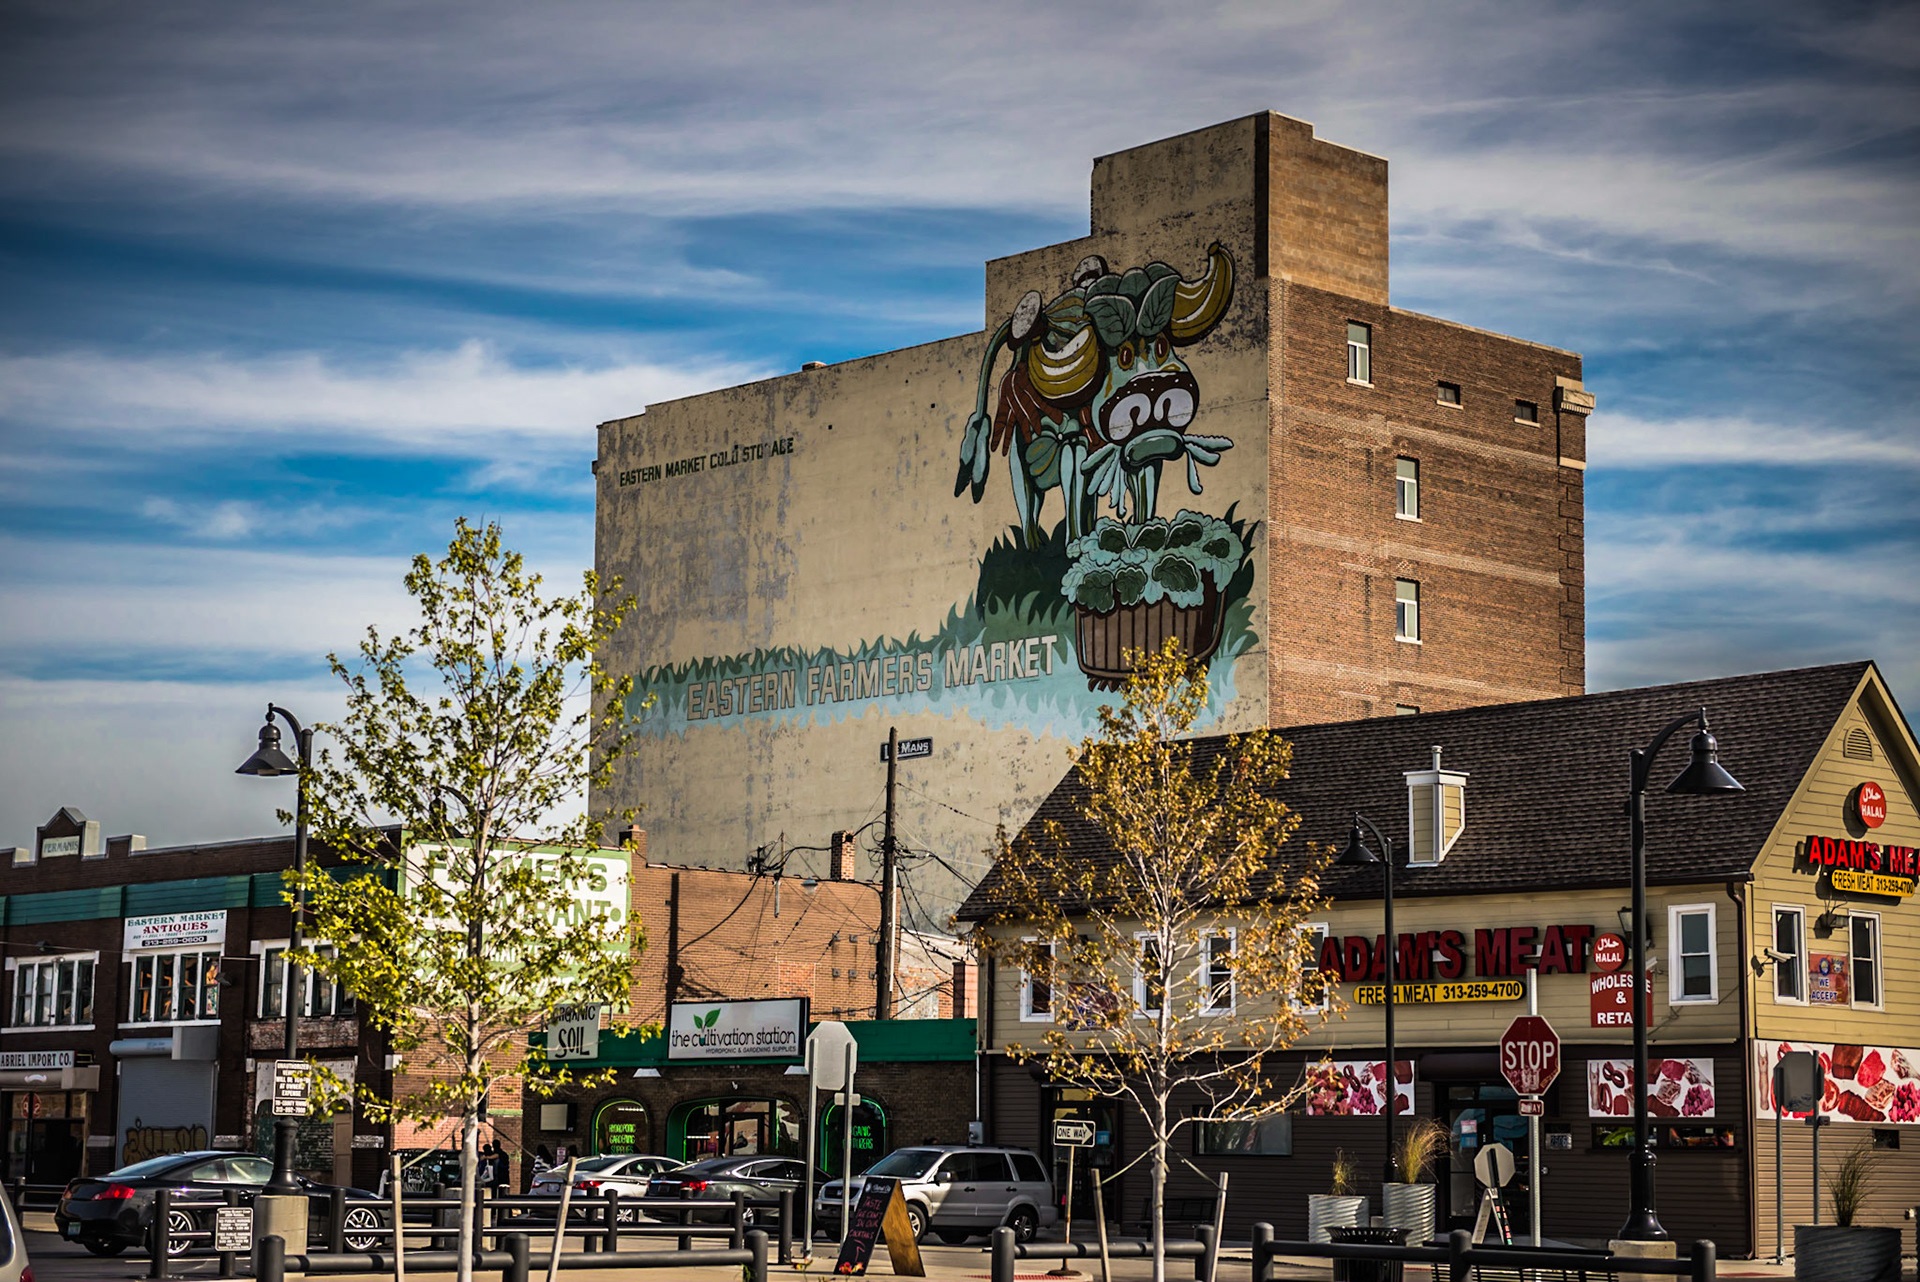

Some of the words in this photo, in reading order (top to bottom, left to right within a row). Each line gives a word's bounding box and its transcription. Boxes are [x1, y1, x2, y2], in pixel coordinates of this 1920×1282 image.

[619, 464, 662, 488] EASTERN
[665, 455, 707, 479] MARKET
[686, 670, 796, 721] EASTERN
[806, 651, 933, 706] FARMERS
[944, 635, 1058, 688] MARKET
[1861, 804, 1884, 818] HALAL
[1809, 836, 1881, 871] ADAM'S
[1833, 872, 1857, 890] FRESH
[1857, 874, 1874, 892] MEAT
[127, 915, 176, 927] EASTERN
[180, 911, 226, 922] MARKET
[143, 921, 209, 935] ANTIQUES
[1319, 929, 1466, 982] ADAM'S
[1475, 924, 1595, 976] MEAT
[1595, 952, 1622, 962] HALAL
[1592, 974, 1651, 994] WHOLESE
[1819, 978, 1830, 987] WE
[1403, 984, 1438, 1003] MEAT
[1442, 982, 1520, 999] 313-259-4700
[1616, 991, 1627, 1004] &
[1811, 991, 1838, 1001] ACCEPT
[1597, 1012, 1634, 1025] RETA
[555, 1026, 590, 1059] SOIL
[672, 1030, 690, 1047] the
[691, 1028, 754, 1047] cultivation
[756, 1026, 796, 1045] station
[28, 1053, 57, 1067] IMPORT
[59, 1052, 72, 1066] CO.
[1505, 1041, 1555, 1070] STOP
[1058, 1128, 1071, 1138] ONE
[1073, 1128, 1088, 1138] WAY
